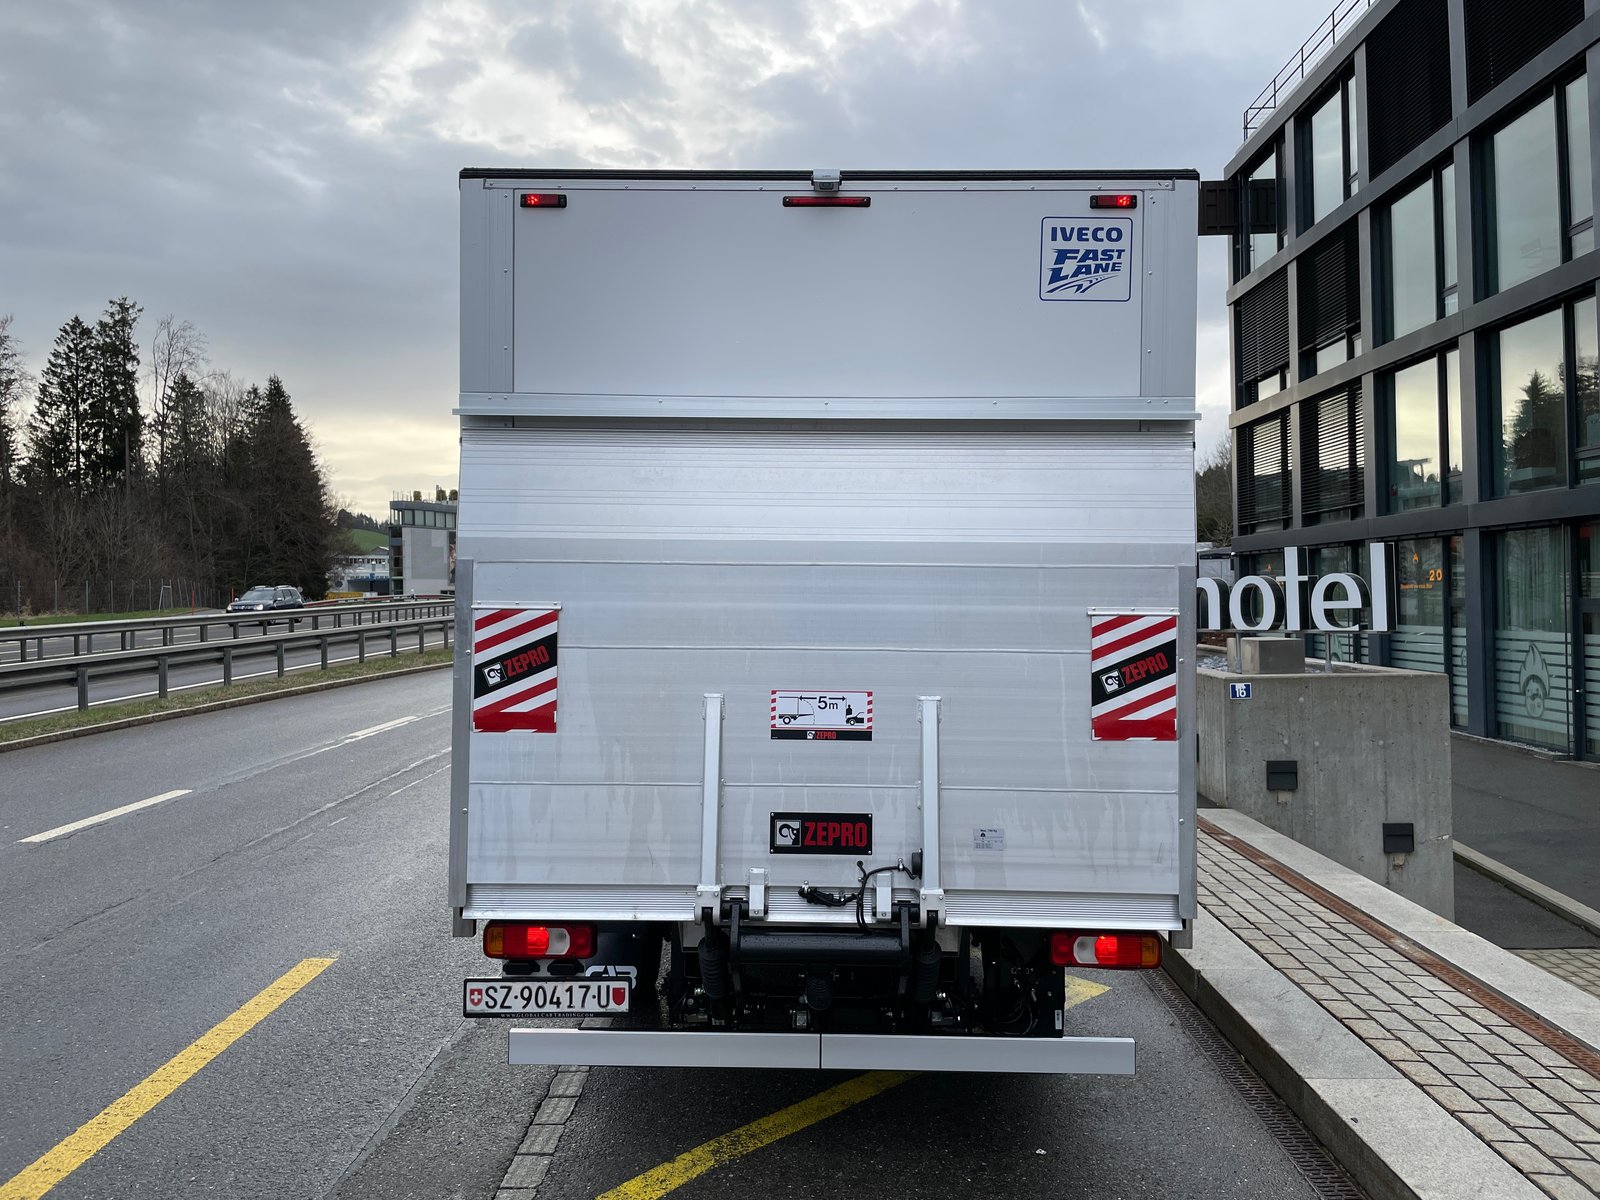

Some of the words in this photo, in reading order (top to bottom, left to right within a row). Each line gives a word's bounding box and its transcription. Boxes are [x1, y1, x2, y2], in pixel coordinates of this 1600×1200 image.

[1050, 226, 1123, 242] IVECO
[1051, 248, 1125, 265] FAST
[1047, 262, 1122, 285] LANE
[1429, 569, 1442, 581] 20
[503, 645, 550, 677] ZEPRO
[1121, 652, 1169, 684] ZEPRO
[816, 731, 837, 739] ZEPRO
[804, 821, 868, 847] ZEPRO
